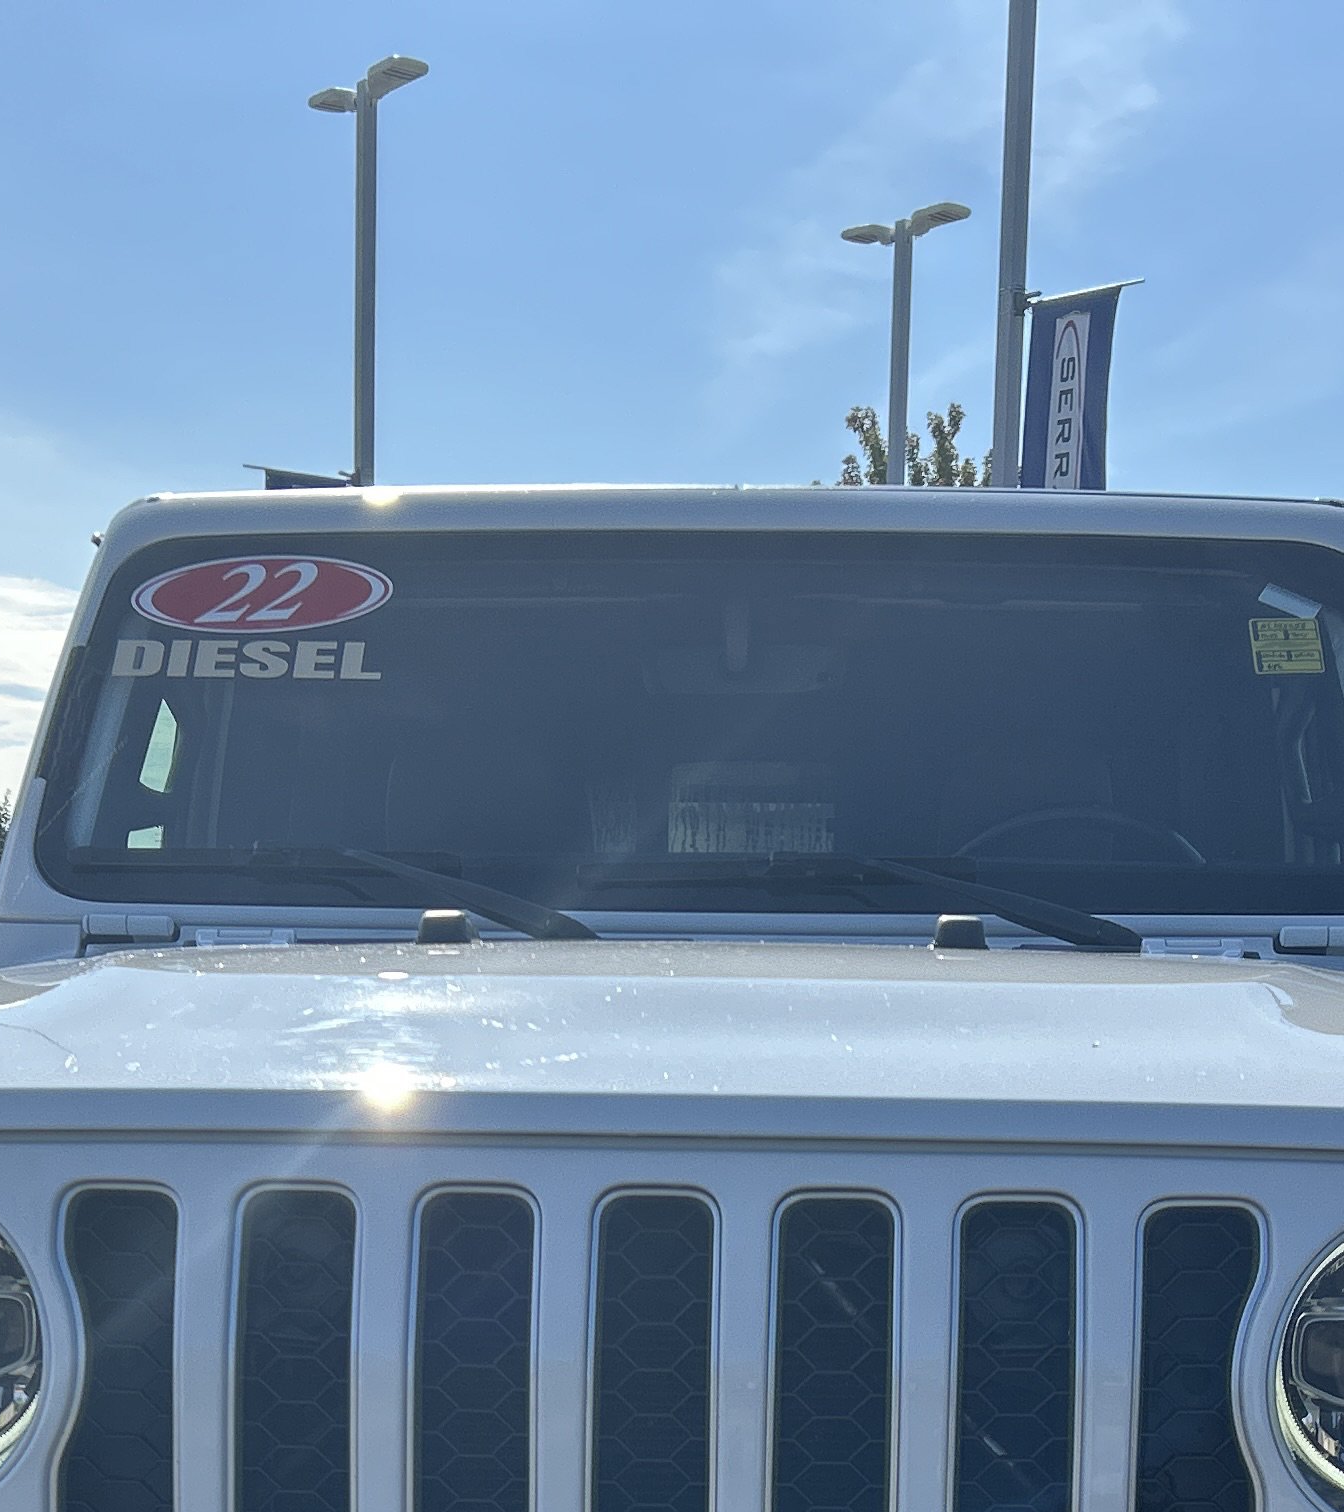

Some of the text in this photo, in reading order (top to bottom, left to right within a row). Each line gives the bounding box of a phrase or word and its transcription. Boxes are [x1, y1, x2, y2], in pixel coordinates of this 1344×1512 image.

[1053, 355, 1076, 489] SERR
[193, 561, 319, 623] 22
[111, 639, 382, 681] DIESEL
